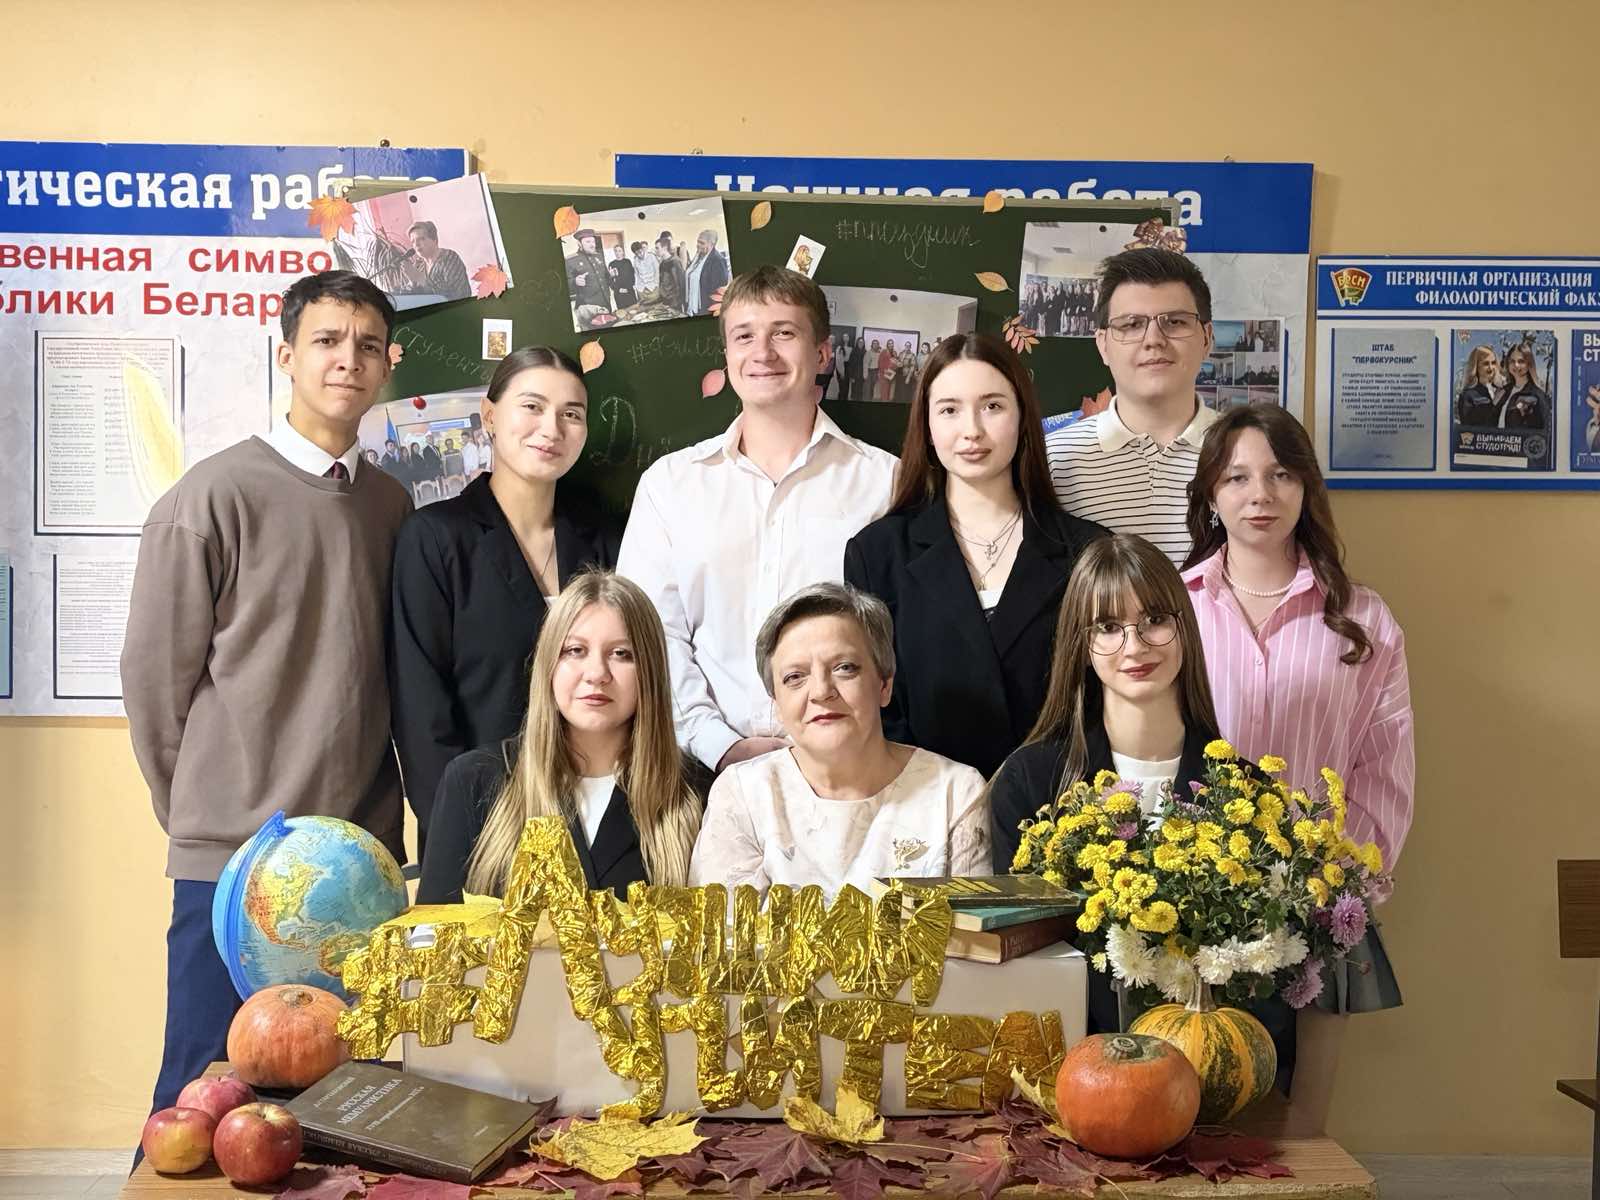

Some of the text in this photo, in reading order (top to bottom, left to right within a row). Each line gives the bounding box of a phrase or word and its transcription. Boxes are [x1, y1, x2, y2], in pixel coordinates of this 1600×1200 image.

[0, 170, 233, 210] ическая
[1386, 271, 1592, 289] ПЕРВИЧНАЯ ОРГАНИЗАЦИЯ
[0, 280, 114, 316] лики
[1415, 289, 1560, 306] ФИЛОЛОГИЧЕСКИЙ
